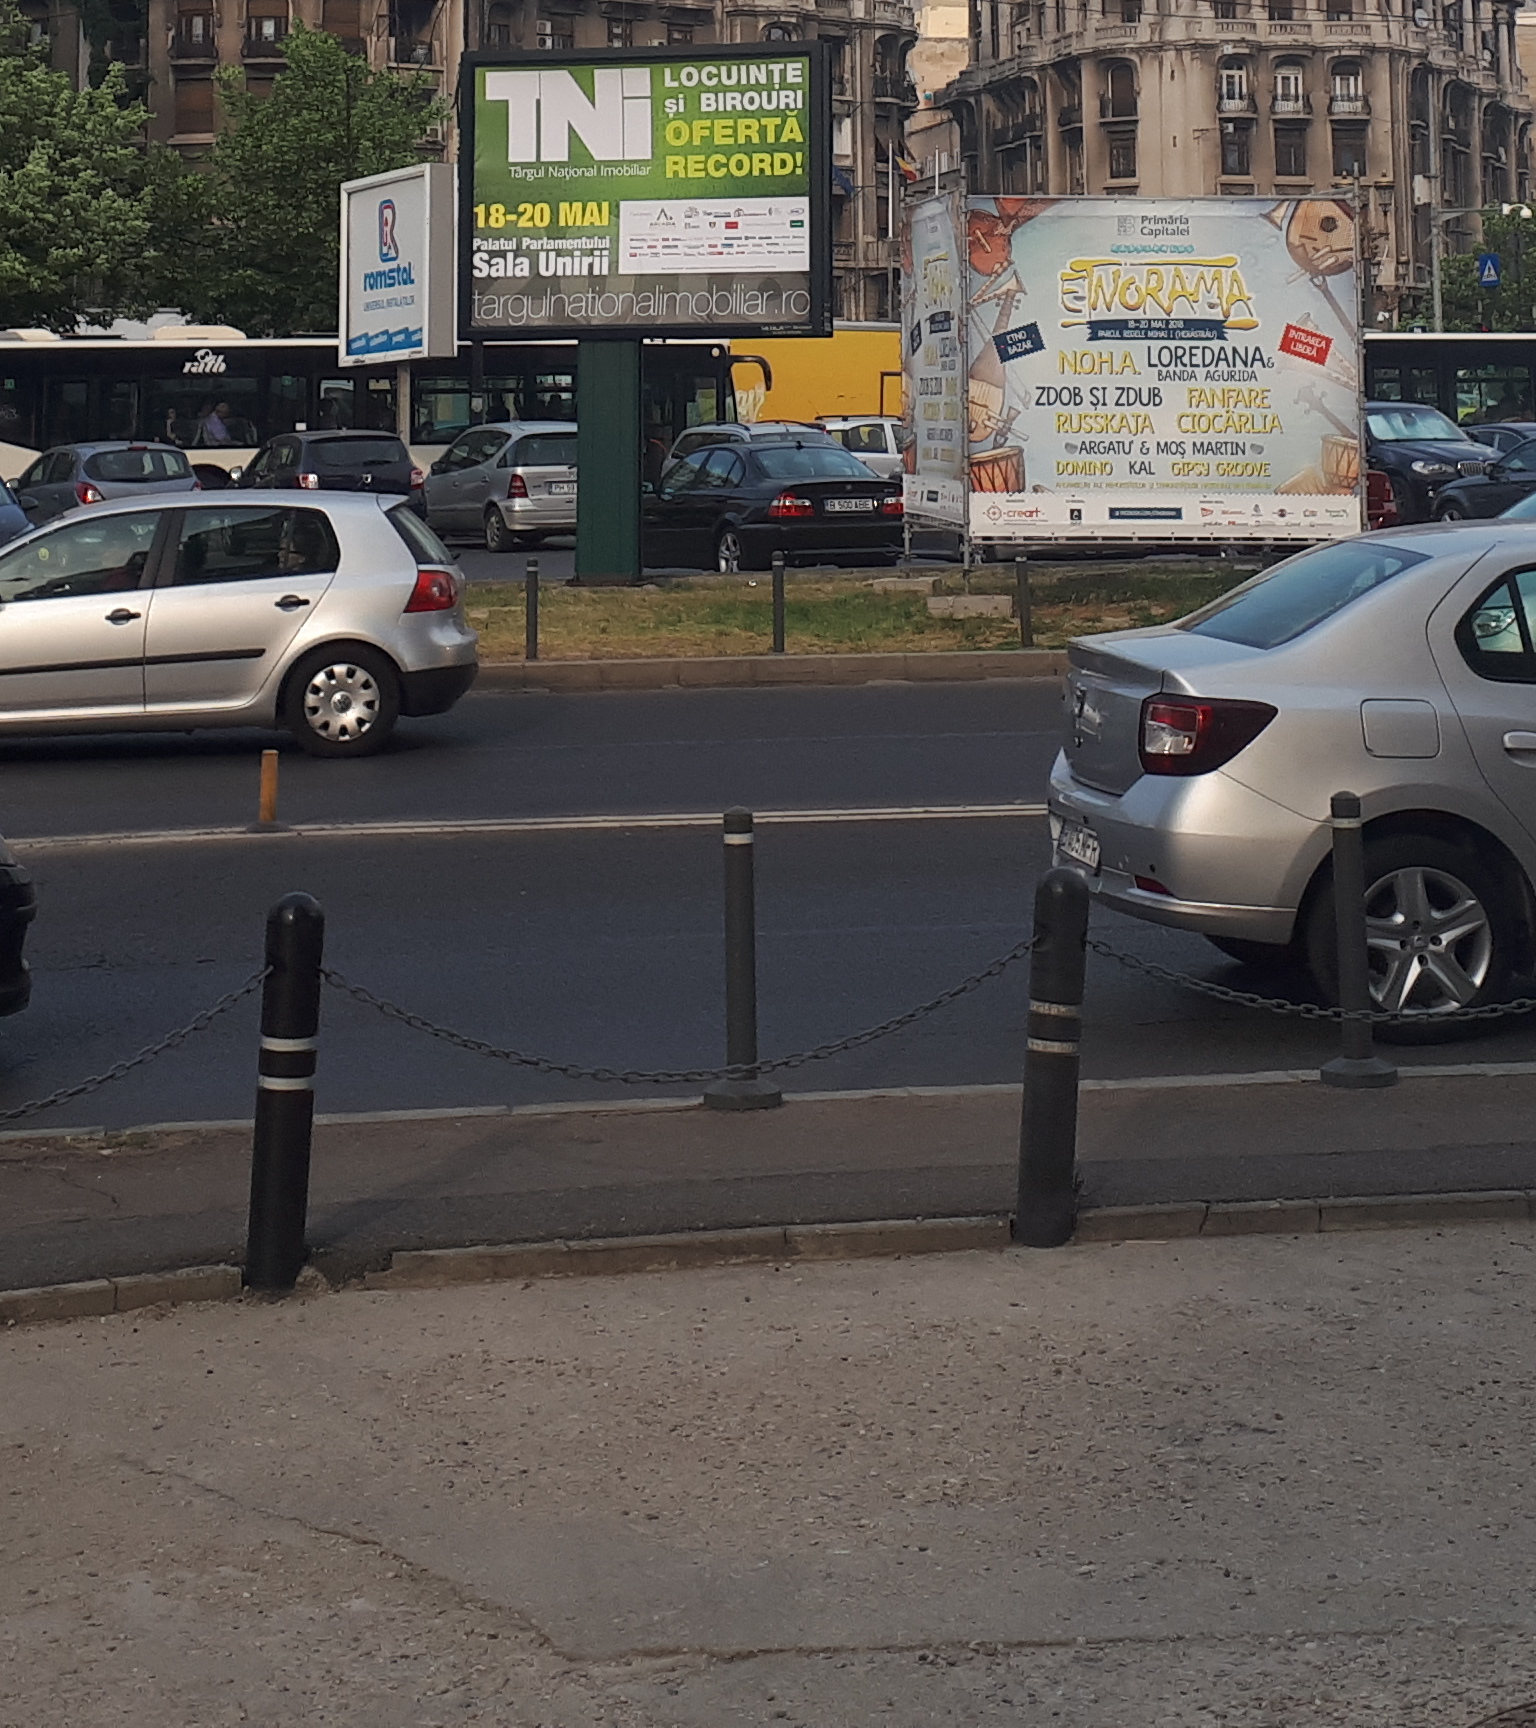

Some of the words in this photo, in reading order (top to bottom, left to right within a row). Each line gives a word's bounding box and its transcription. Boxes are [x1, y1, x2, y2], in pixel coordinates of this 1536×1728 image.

[664, 62, 803, 90] LOCUINȚE
[700, 89, 803, 112] BIROURI
[665, 110, 804, 146] OFERTĂ
[509, 165, 545, 181] Târgul
[600, 164, 652, 177] Imobiliar
[665, 152, 803, 178] RECORD!
[473, 202, 551, 229] 18-20
[559, 201, 609, 226] MAI
[1141, 215, 1189, 225] Primăria
[1140, 226, 1190, 239] Capitalei
[472, 237, 516, 251] Palatul
[522, 235, 610, 250] Parlamentului
[472, 252, 529, 278] Sala
[538, 250, 609, 277] Unirii
[364, 261, 415, 292] romstal
[1151, 320, 1166, 328] MAI
[1006, 330, 1027, 344] ETNO
[1058, 350, 1141, 375] N.O.H.A.
[1147, 345, 1266, 368] LOREDANA
[1266, 356, 1275, 368] &
[1158, 370, 1198, 382] BANDA
[1204, 370, 1258, 382] AGURIDA
[1035, 387, 1083, 406] ZDOB
[1114, 387, 1163, 407] ZDUB
[1187, 387, 1271, 409] FANFARE
[1055, 412, 1155, 436] RUSSKAJA
[1140, 441, 1150, 455] &
[1192, 441, 1246, 455] MARTIN
[1055, 461, 1113, 476] DOMINO
[1129, 461, 1155, 475] KAL
[1171, 462, 1210, 477] GIPSY
[1216, 462, 1271, 477] GROOVE
[1006, 507, 1040, 518] creart
